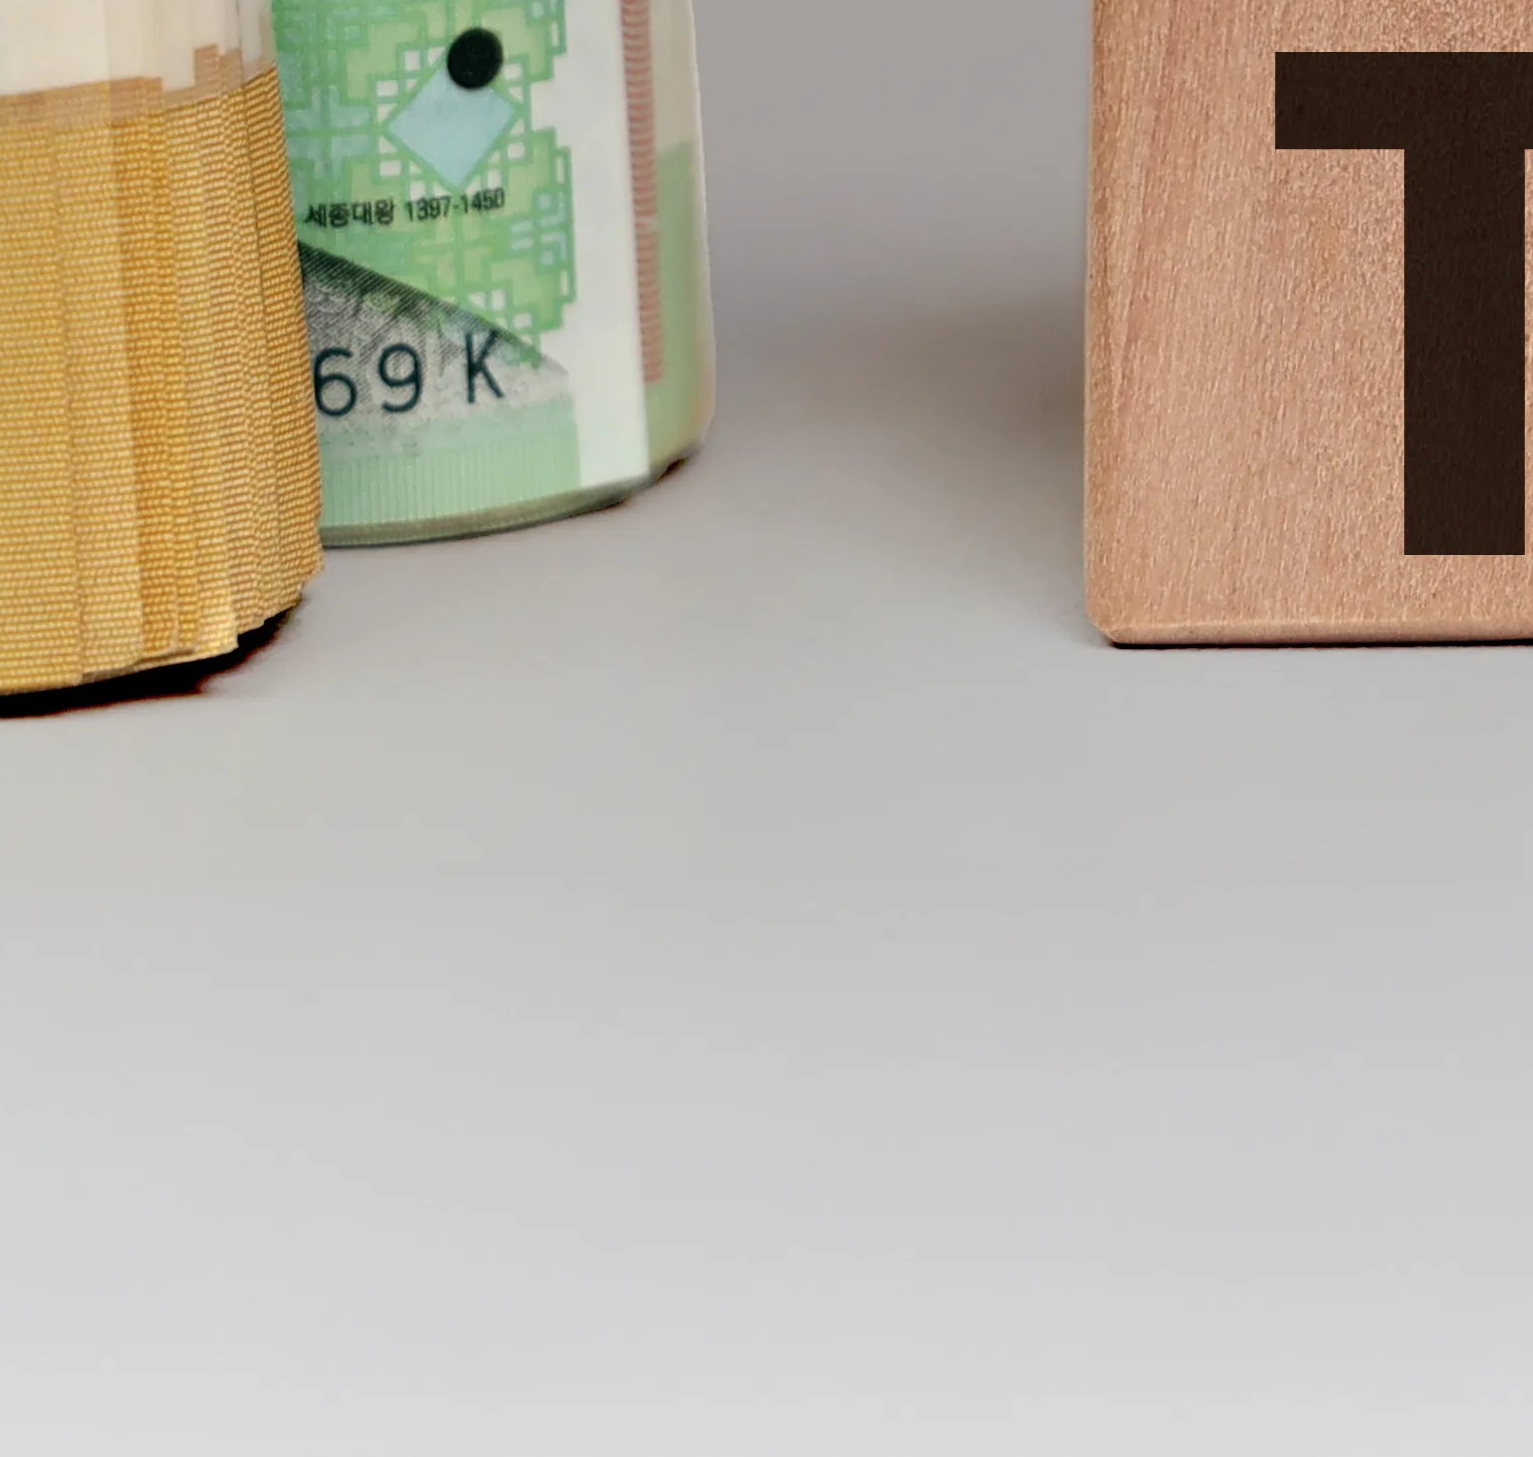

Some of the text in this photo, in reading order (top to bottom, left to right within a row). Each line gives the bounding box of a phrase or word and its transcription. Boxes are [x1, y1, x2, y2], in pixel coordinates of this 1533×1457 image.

[303, 187, 506, 228] 세종대왕 1397-1450
[464, 331, 505, 404] K
